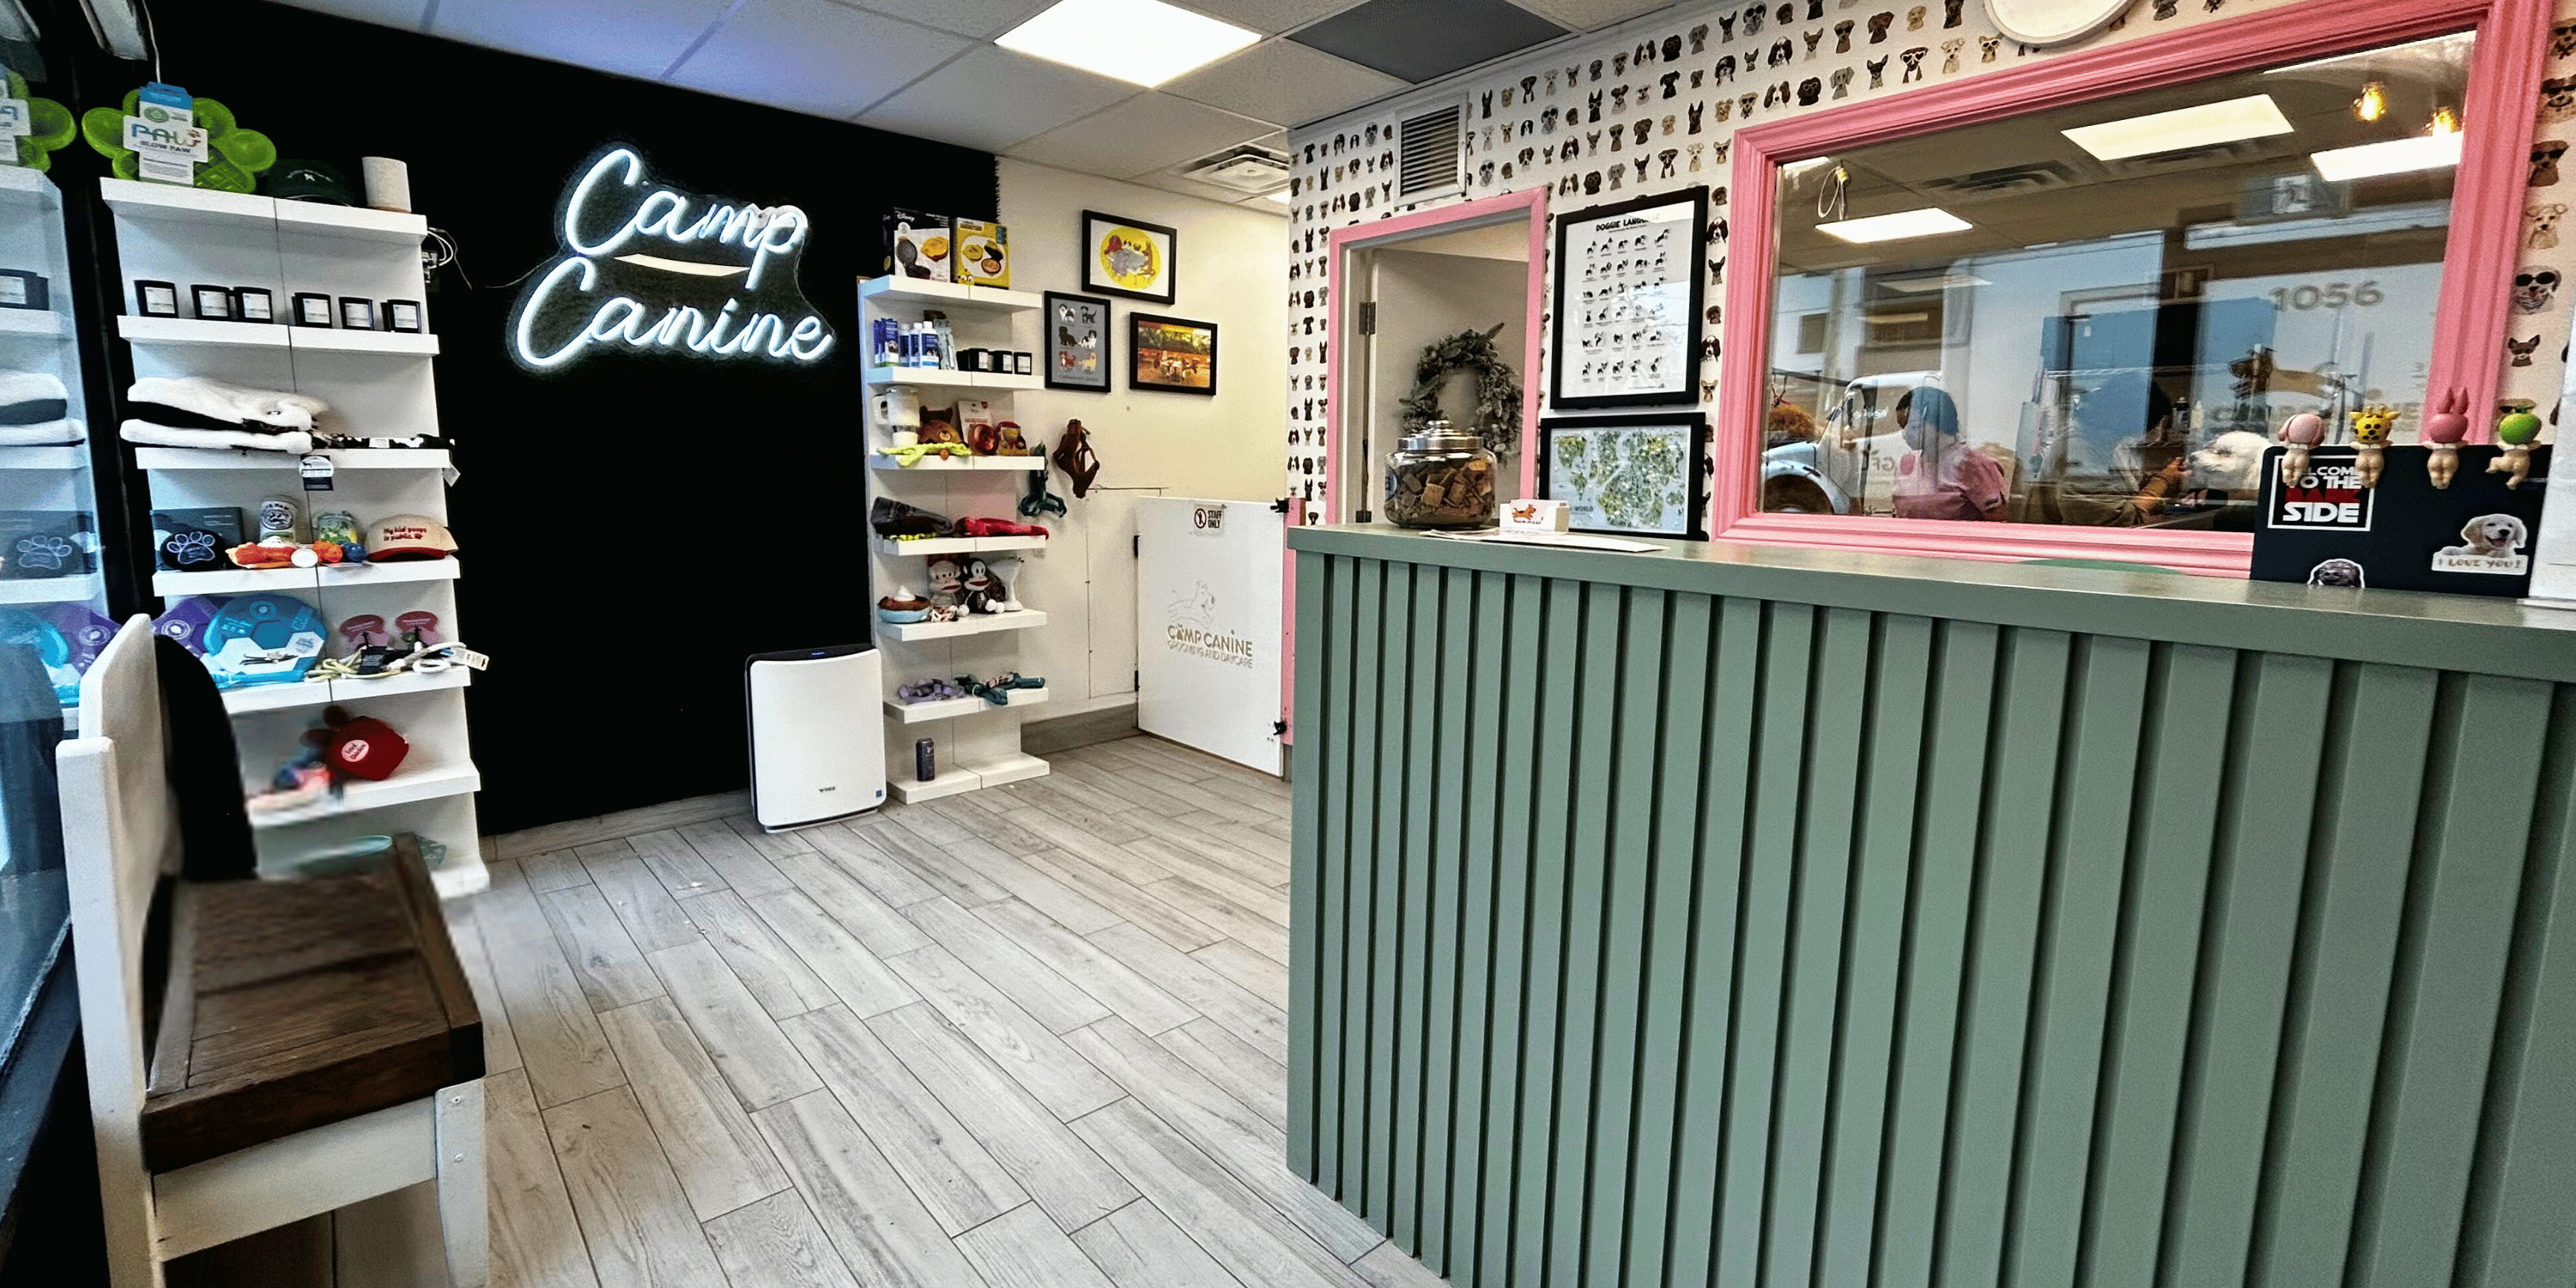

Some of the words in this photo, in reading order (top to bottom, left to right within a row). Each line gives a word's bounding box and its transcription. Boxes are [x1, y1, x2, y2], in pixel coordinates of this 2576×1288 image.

[139, 140, 168, 150] SLOW
[169, 145, 191, 153] PAW
[565, 148, 809, 289] Camp
[894, 210, 915, 223] Disney
[1596, 221, 1620, 232] DOGGIE
[2268, 280, 2384, 313] 1056
[517, 256, 833, 367] Canine
[2323, 476, 2362, 489] THE
[1208, 510, 1222, 520] STAFF
[2282, 502, 2360, 523] SIDE
[1208, 520, 1220, 528] ONLY
[1167, 624, 1202, 644] CAMP
[1203, 629, 1253, 657] CANINE
